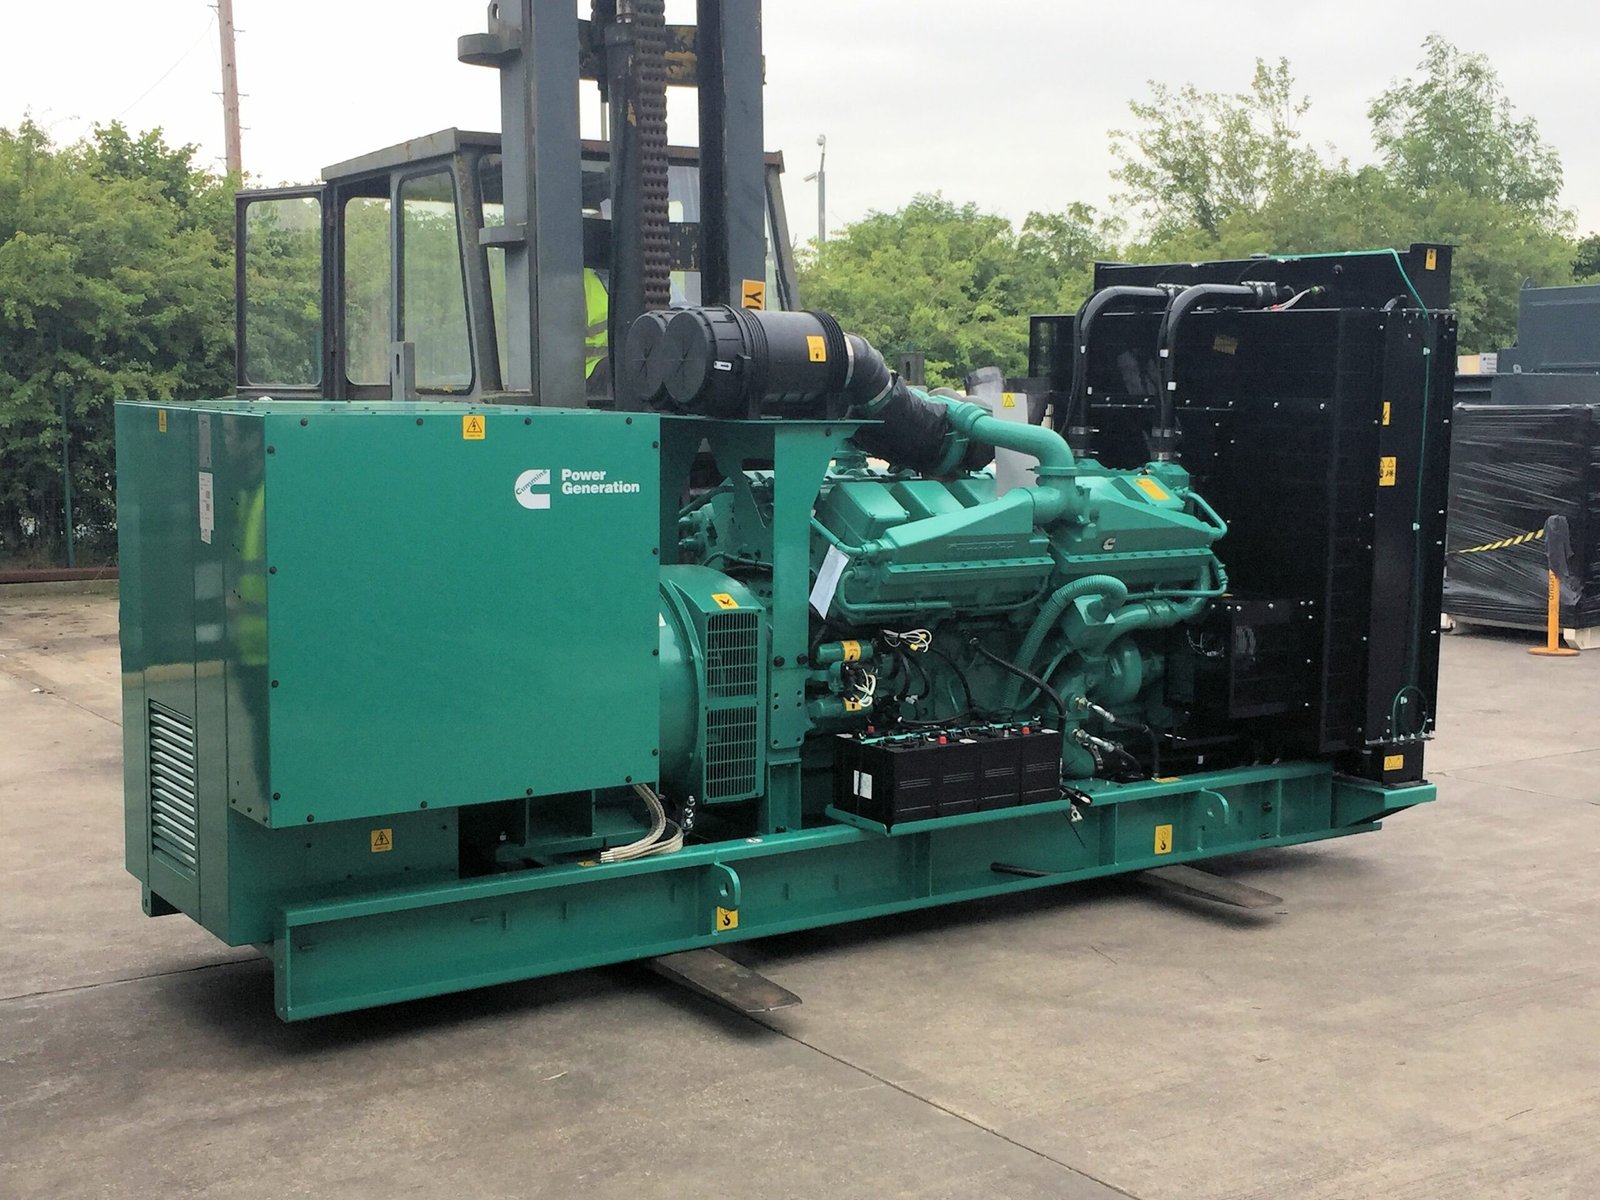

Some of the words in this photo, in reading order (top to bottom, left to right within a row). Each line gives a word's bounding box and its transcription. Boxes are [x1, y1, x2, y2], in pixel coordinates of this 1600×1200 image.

[561, 468, 607, 481] Power
[515, 469, 548, 496] Cummins
[561, 481, 640, 495] Generation
